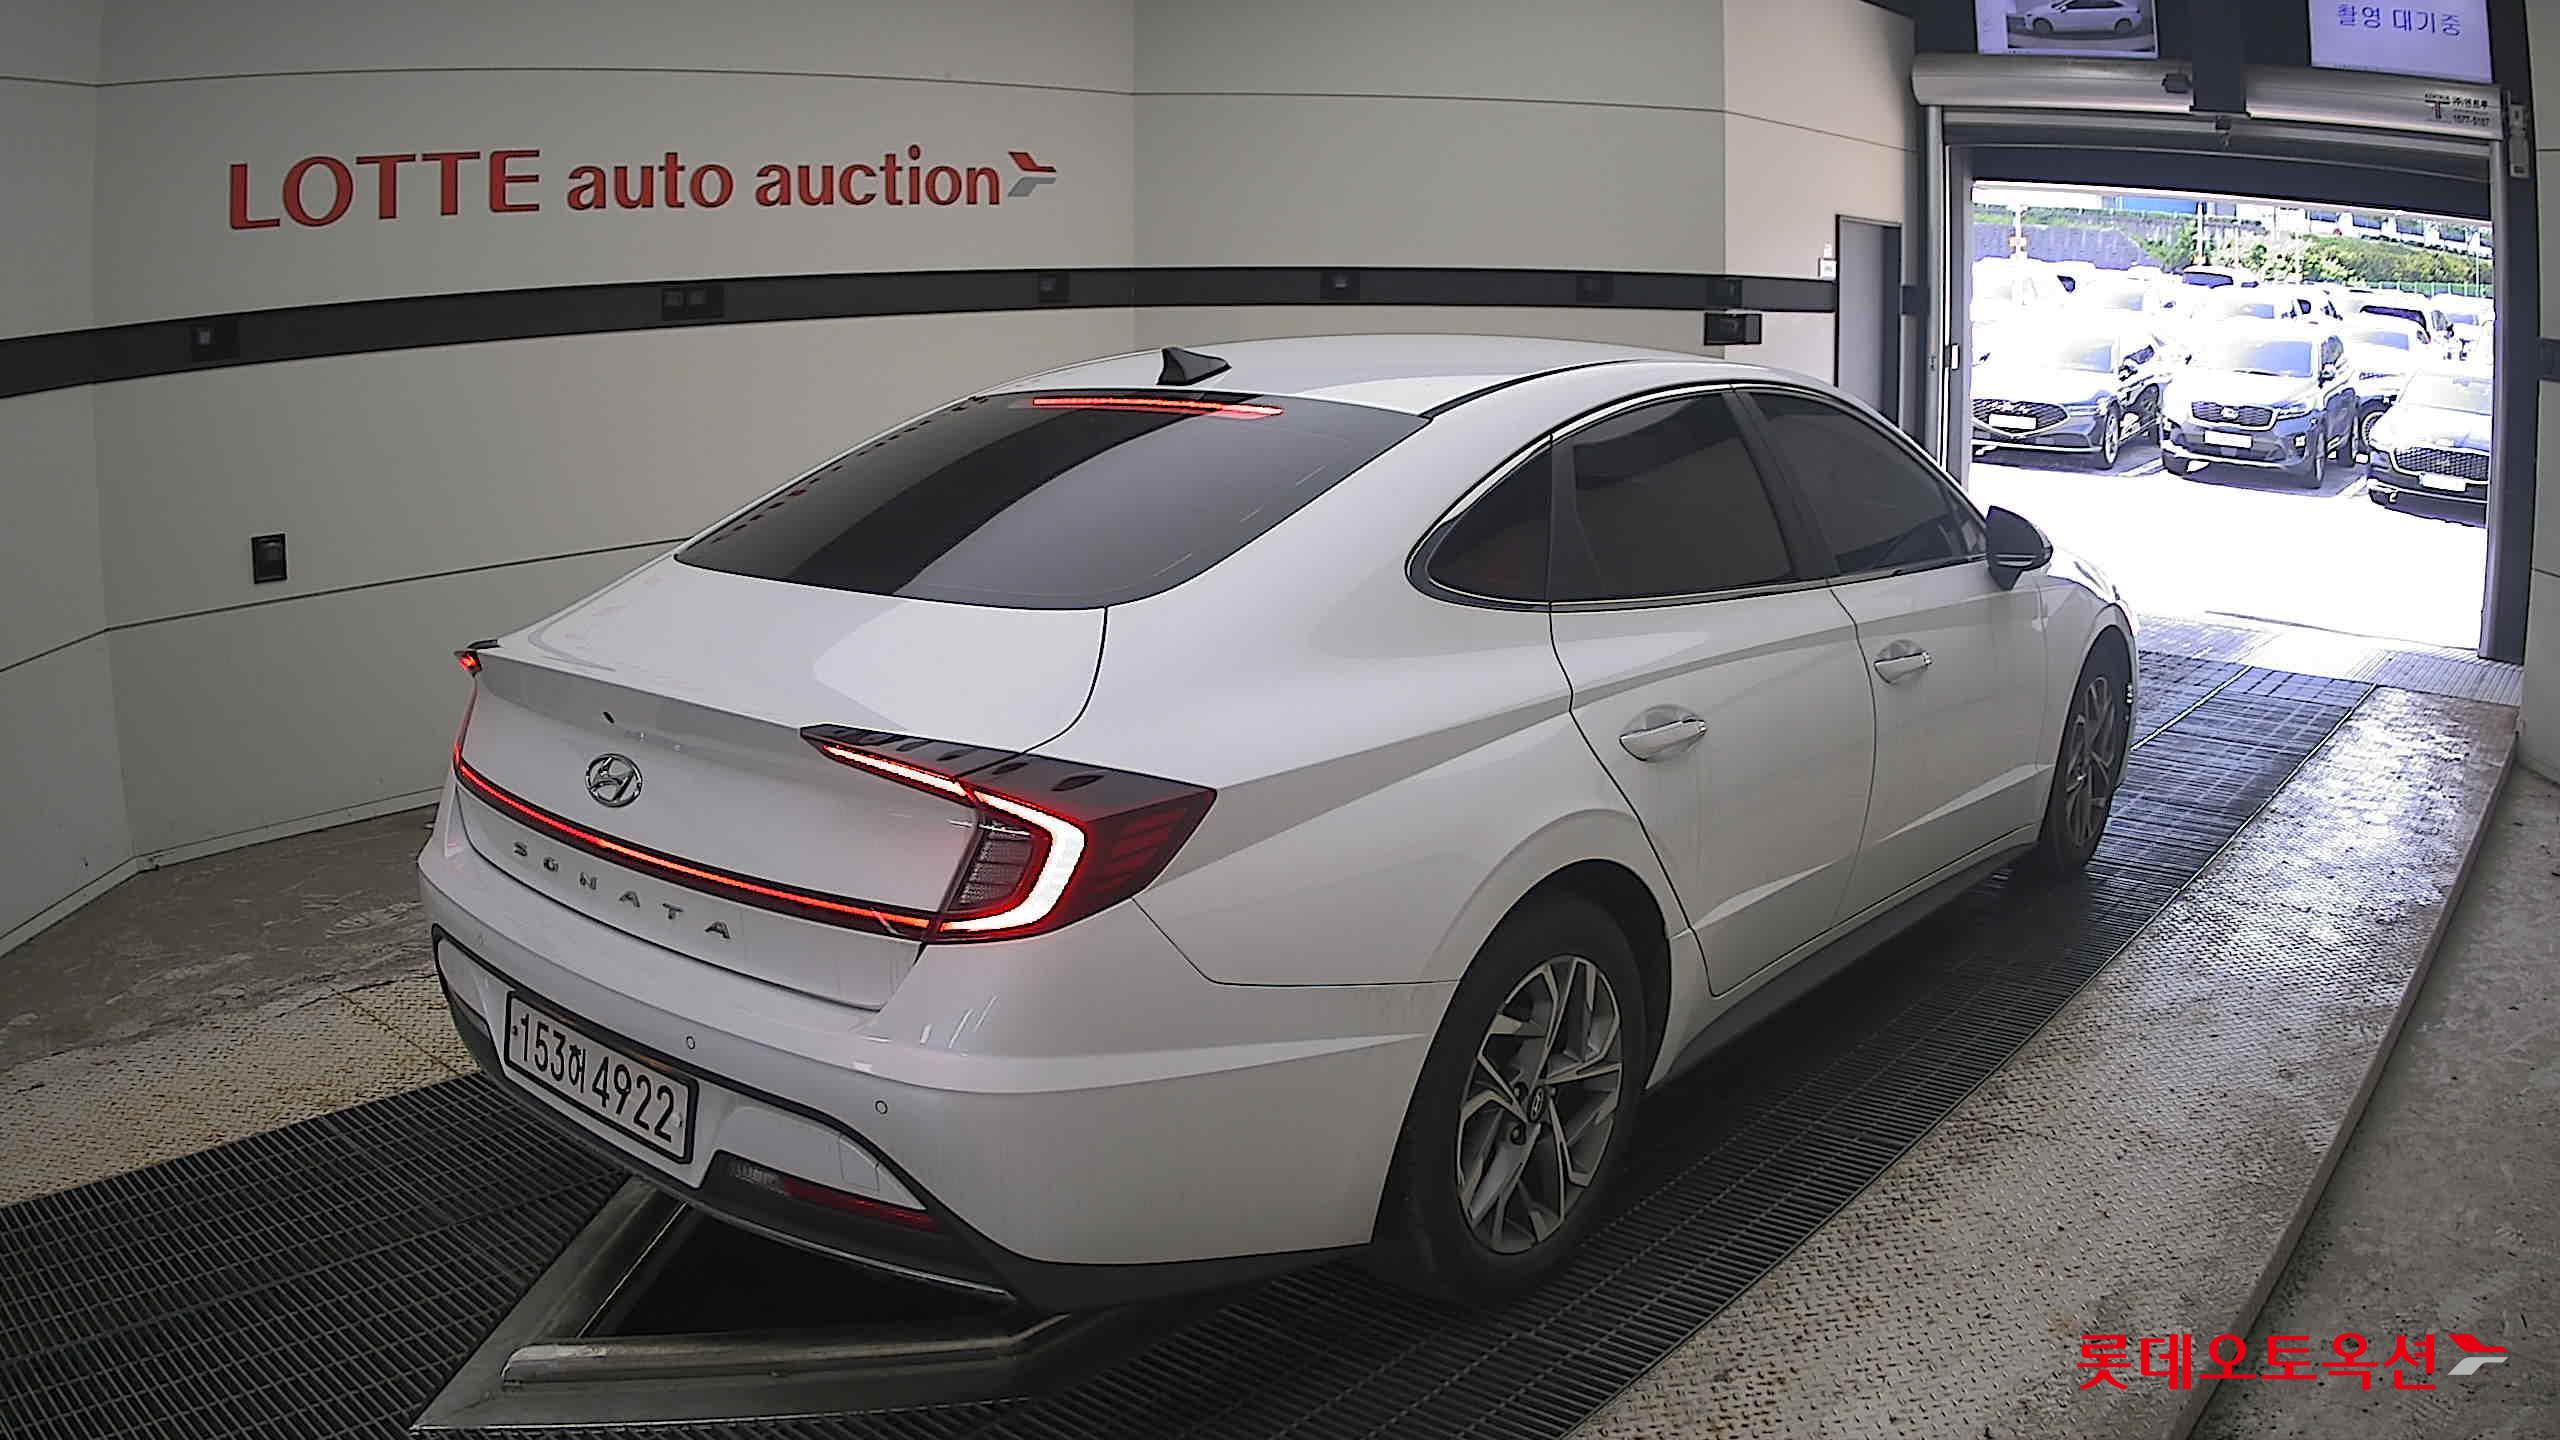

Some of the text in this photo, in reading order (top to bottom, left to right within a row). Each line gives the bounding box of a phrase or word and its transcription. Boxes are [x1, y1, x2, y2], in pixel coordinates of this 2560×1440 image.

[2338, 4, 2461, 37] 촬영 대기중
[230, 145, 1002, 230] LOTTE auto auction
[512, 841, 731, 940] SONATA
